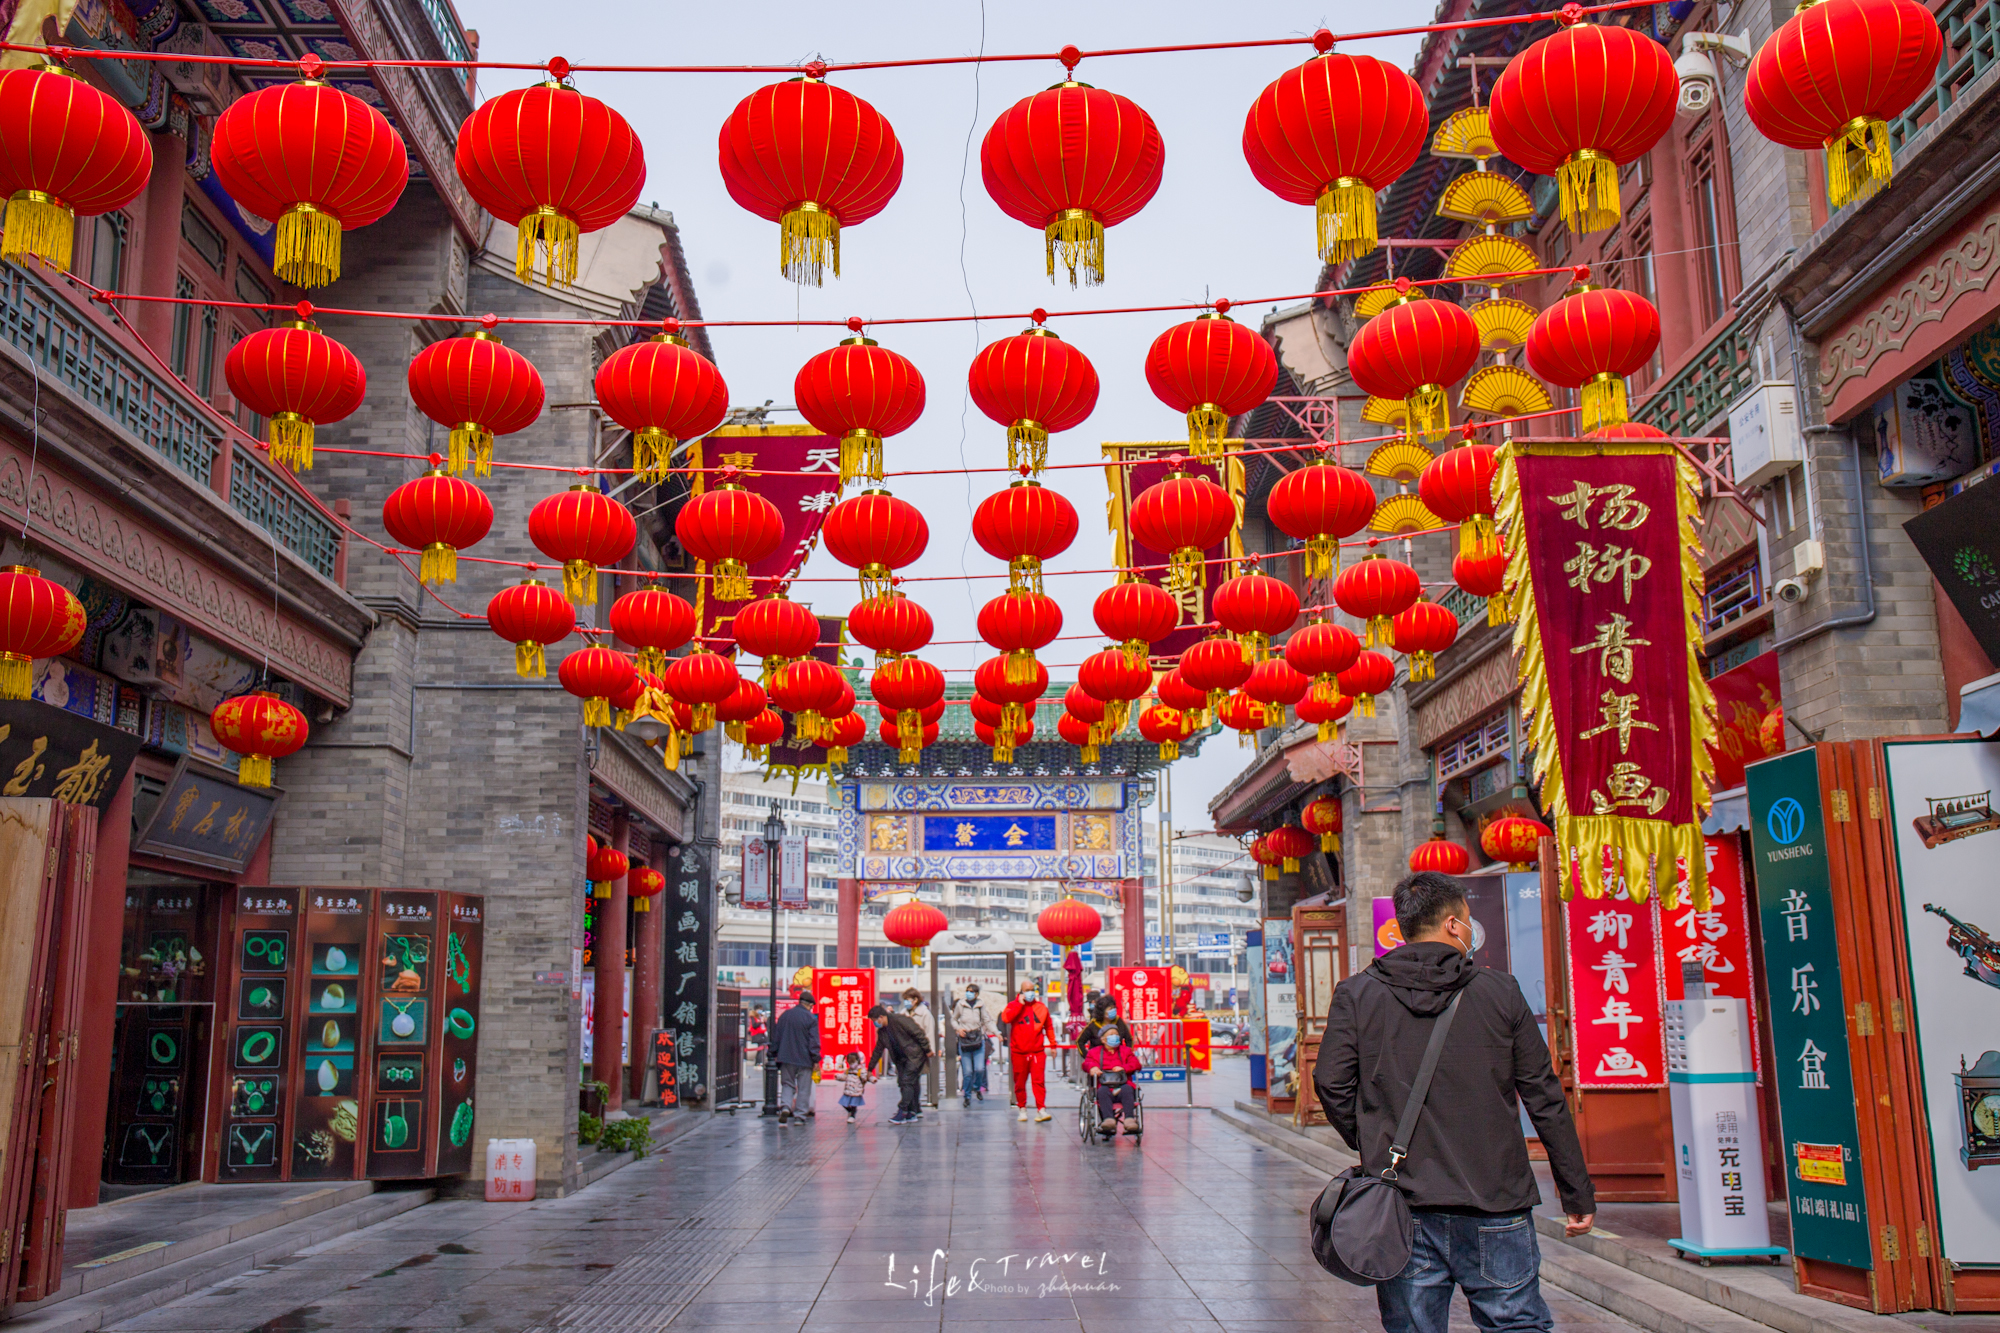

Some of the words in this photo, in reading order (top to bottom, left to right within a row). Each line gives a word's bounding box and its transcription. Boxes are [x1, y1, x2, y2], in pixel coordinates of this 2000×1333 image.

[1547, 479, 1670, 816] 杨柳青年画
[0, 723, 112, 805] 玉都
[1767, 843, 1813, 863] YUNSHENG
[1780, 888, 1830, 1090] 音乐盒
[824, 1006, 836, 1029] 美团
[837, 990, 849, 1045] 祝全国人民
[849, 990, 863, 1045] 节日快乐
[656, 1032, 677, 1106] 欢迎光临
[1715, 1111, 1737, 1122] 扫码
[1716, 1123, 1738, 1134] 使用
[1718, 1147, 1746, 1217] 充电宝
[1801, 1197, 1856, 1222] 高端礼品
